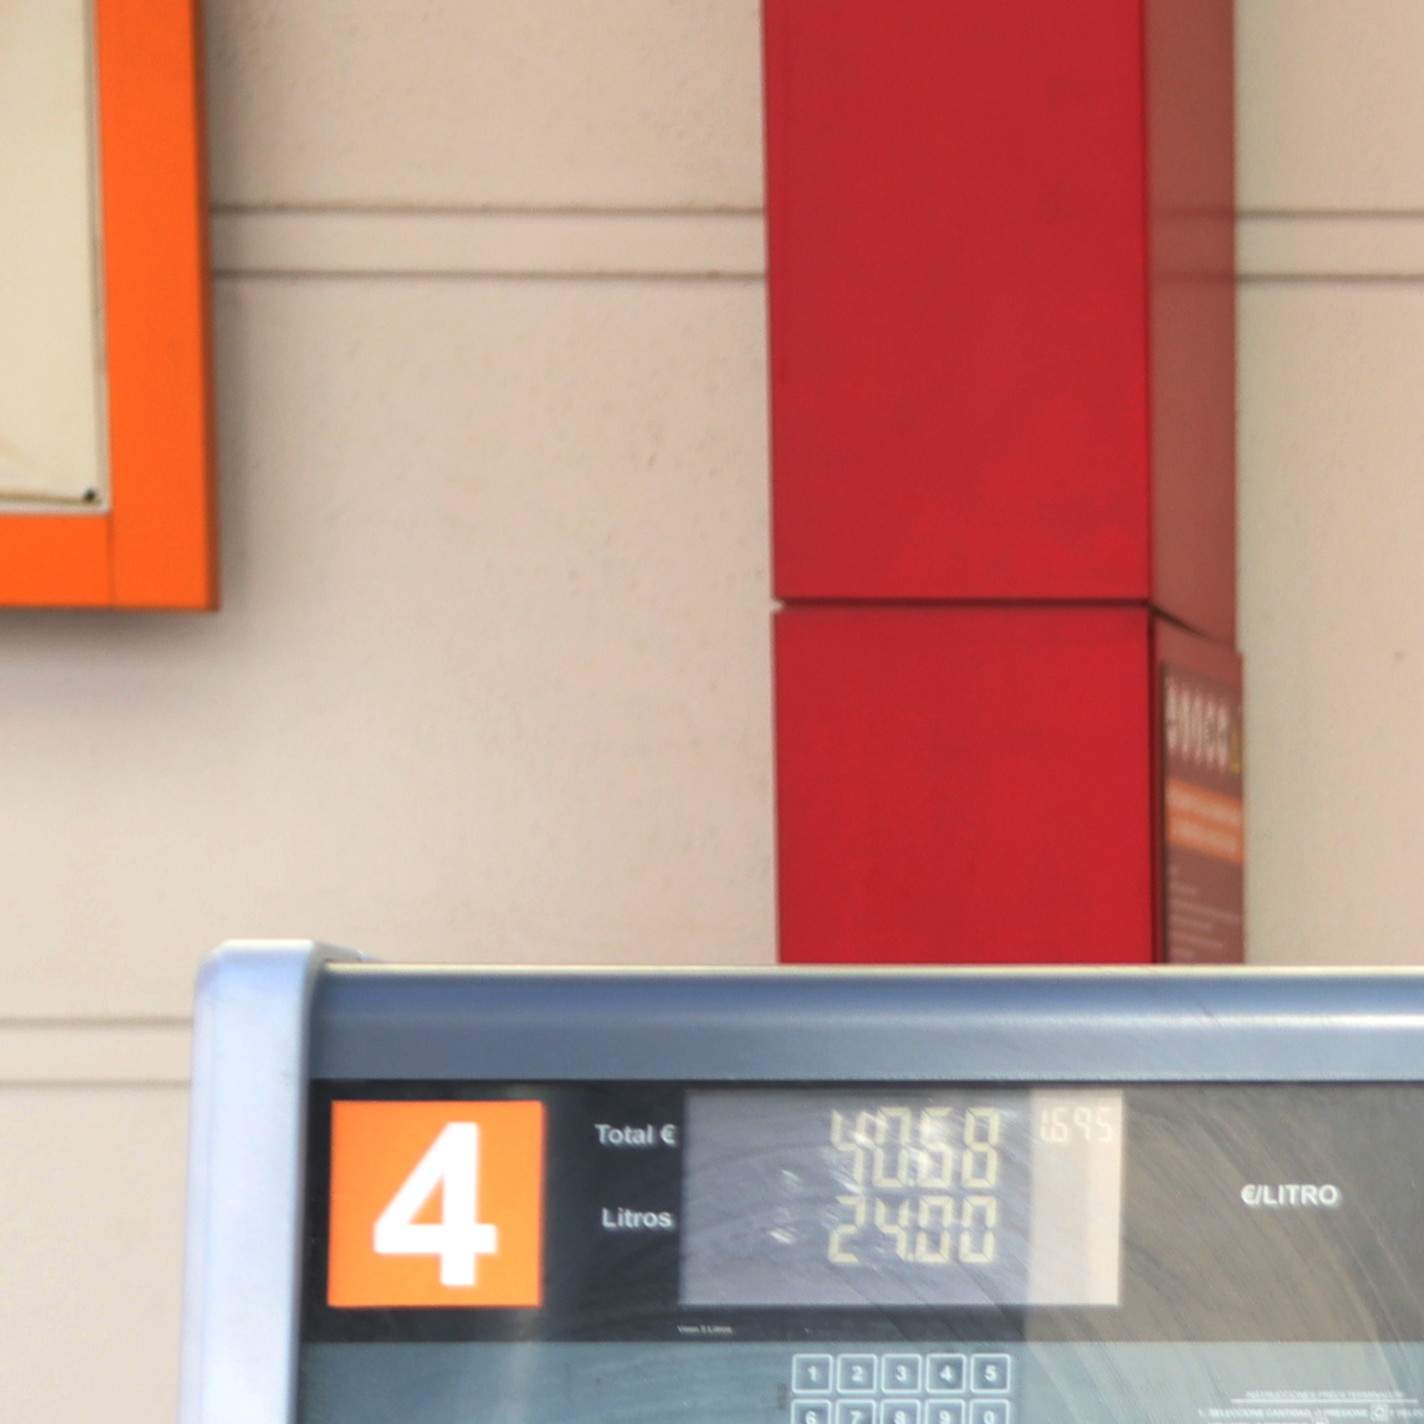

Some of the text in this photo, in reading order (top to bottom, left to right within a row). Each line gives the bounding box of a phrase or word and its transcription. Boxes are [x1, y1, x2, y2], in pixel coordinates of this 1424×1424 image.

[594, 1123, 677, 1146] Total €
[371, 1120, 498, 1285] 4
[1241, 1184, 1339, 1206] €/LITRO
[602, 1207, 674, 1229] Litros
[807, 1365, 997, 1382] 1 2 3 4 5
